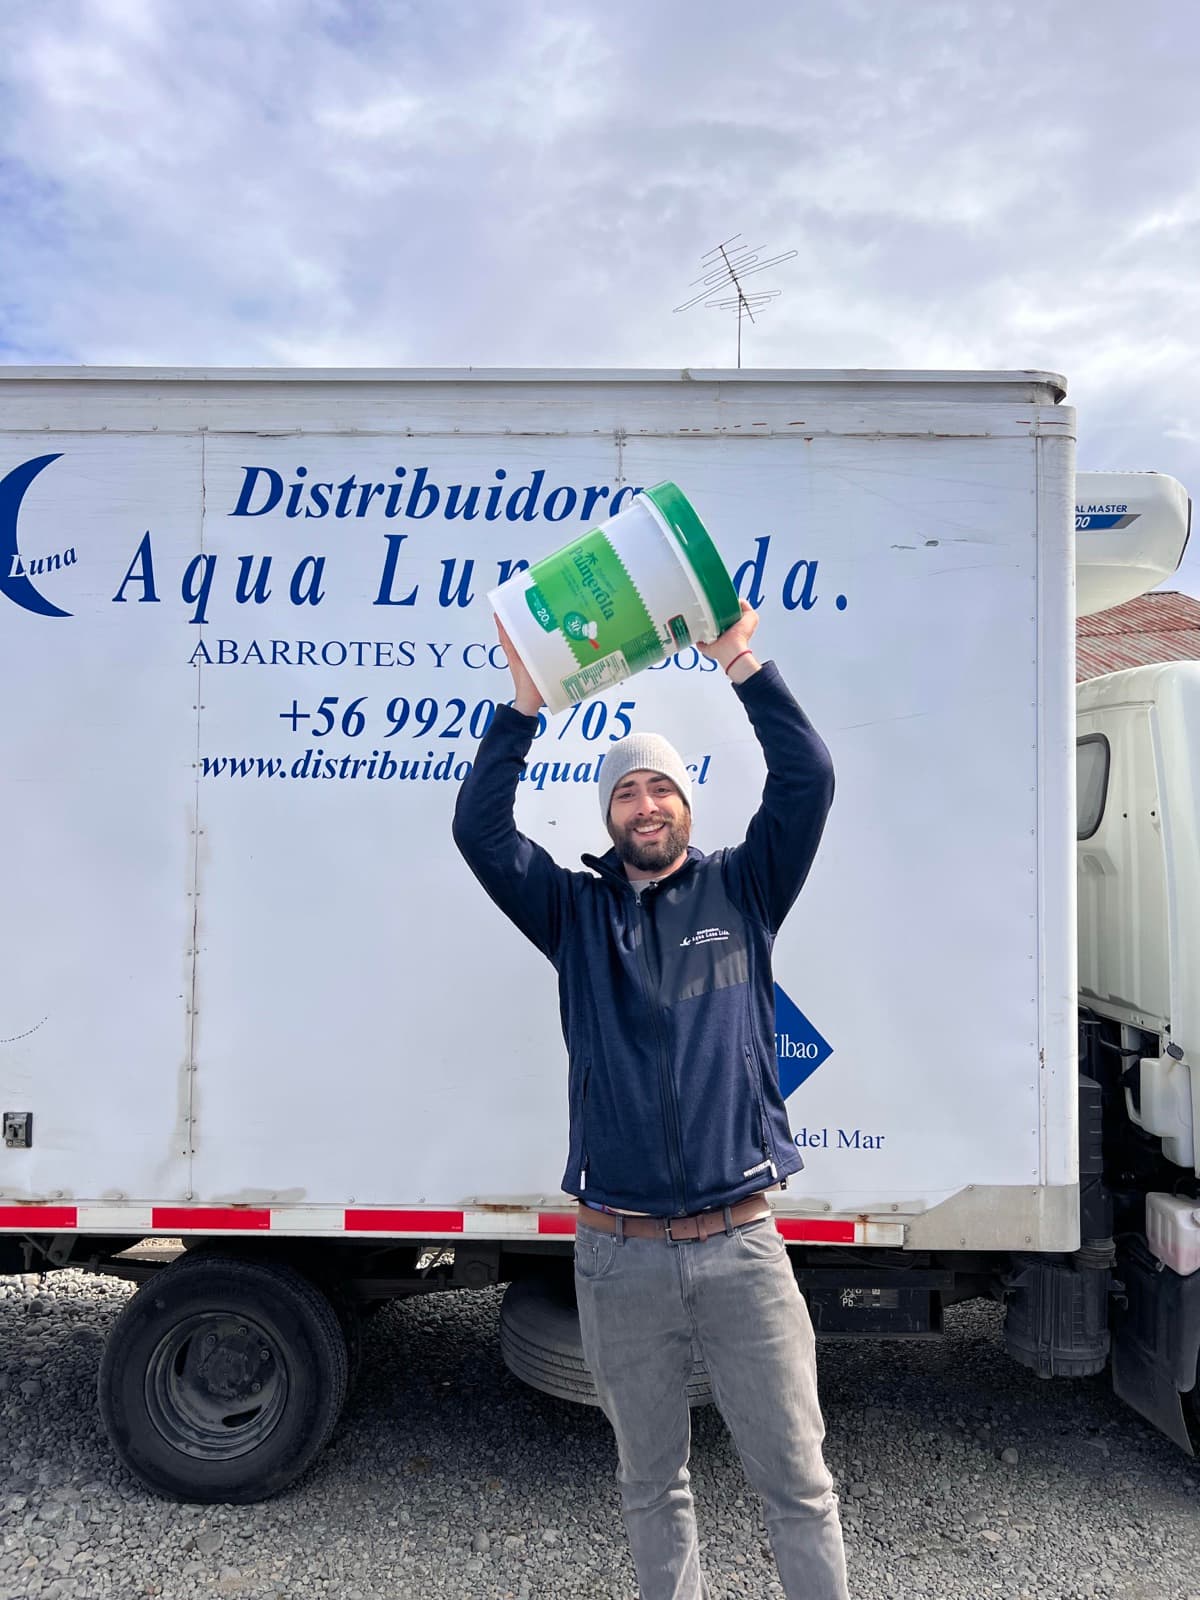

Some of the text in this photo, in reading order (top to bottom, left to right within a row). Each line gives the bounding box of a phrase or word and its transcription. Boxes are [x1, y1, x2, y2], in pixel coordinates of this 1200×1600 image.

[1087, 504, 1128, 513] MASTER
[8, 547, 78, 577] Luna
[112, 530, 326, 624] Aqua
[187, 640, 415, 667] ABARROTES
[427, 643, 452, 668] Y
[280, 697, 368, 737] +56
[794, 1128, 885, 1149] del Mar
